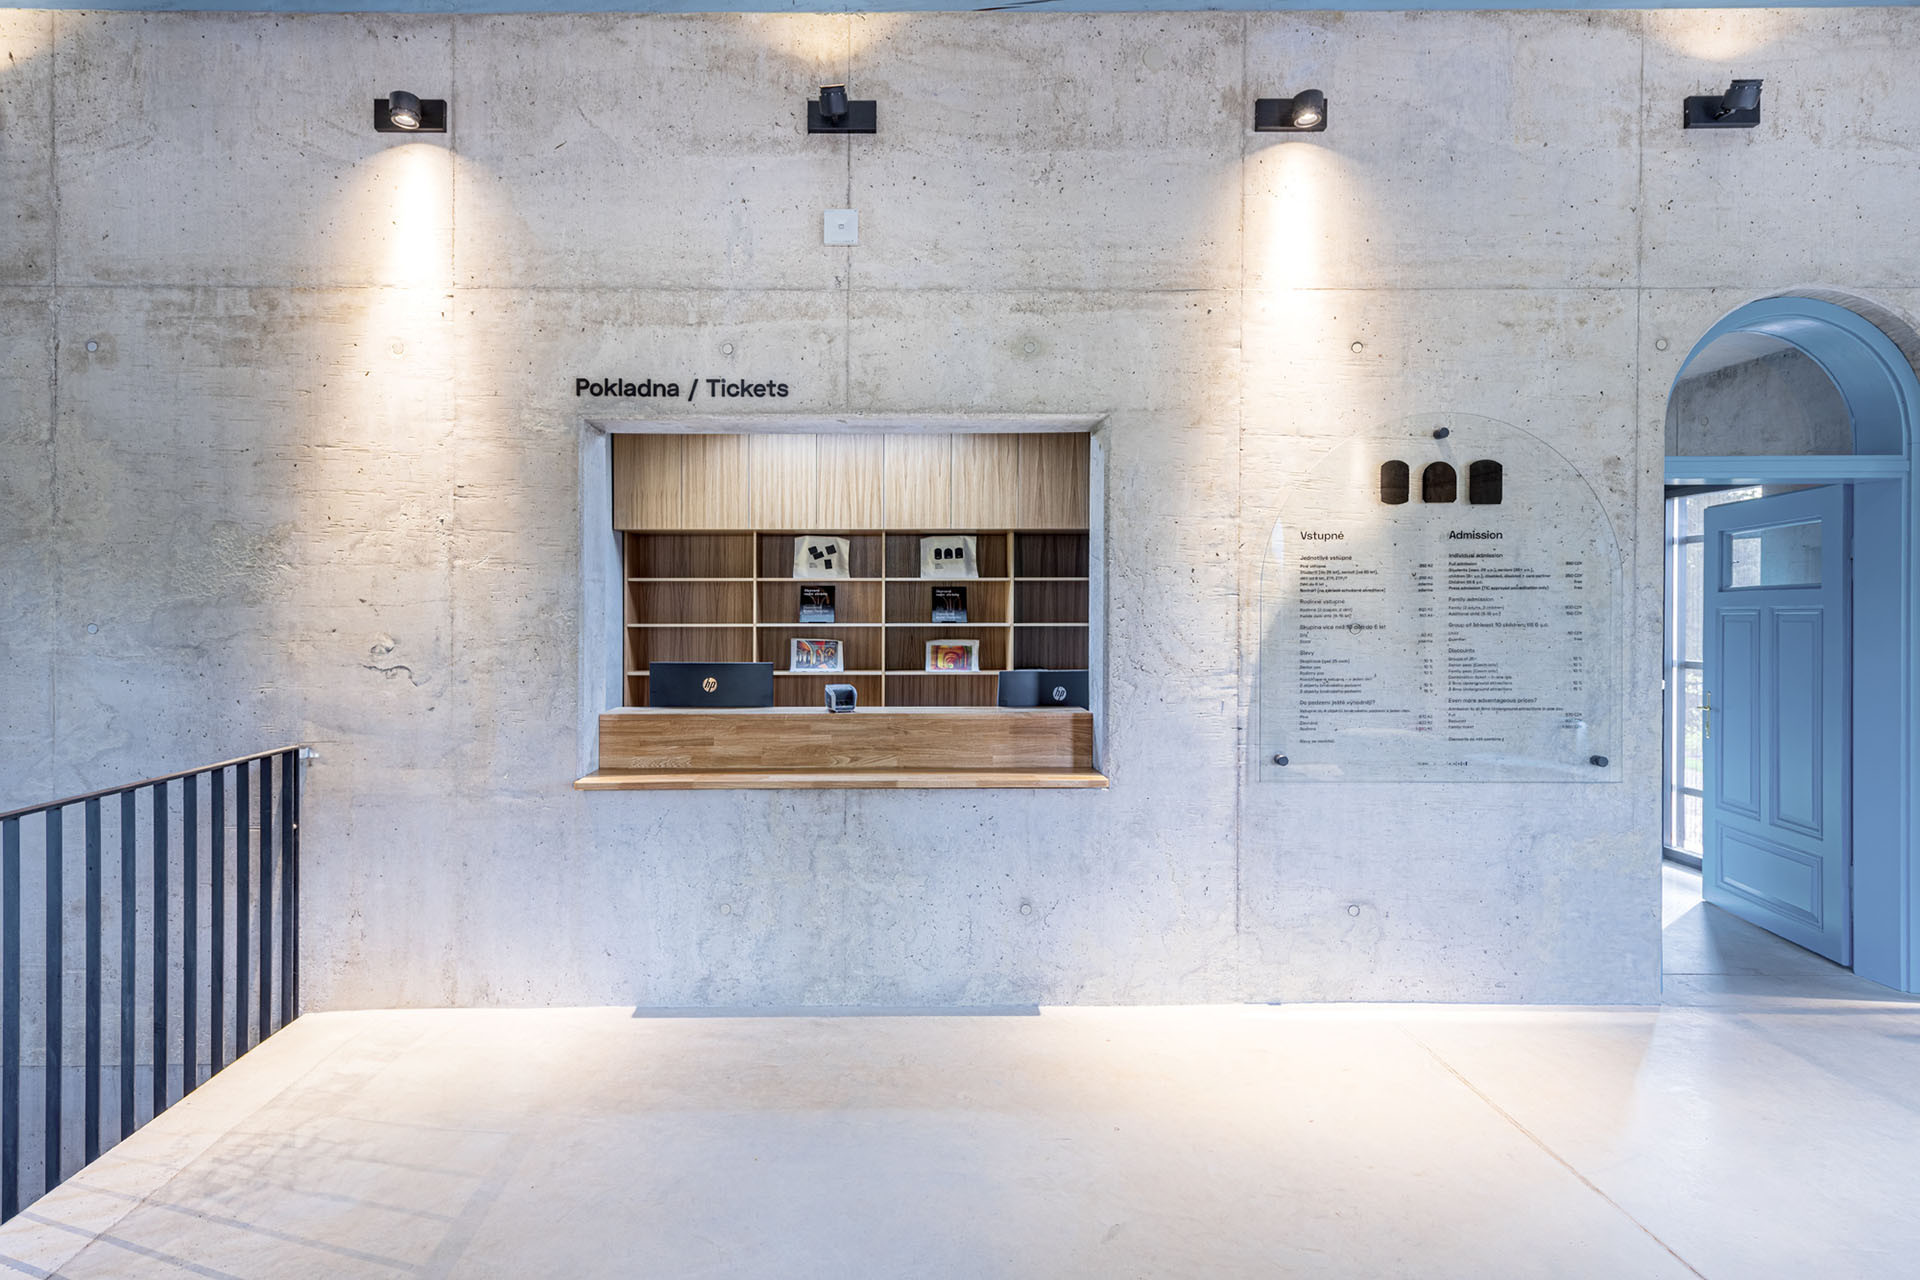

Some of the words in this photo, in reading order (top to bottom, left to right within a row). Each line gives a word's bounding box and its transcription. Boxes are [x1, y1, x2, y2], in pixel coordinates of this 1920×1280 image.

[576, 378, 679, 397] Pokladna
[688, 378, 699, 402] /
[706, 378, 789, 398] Tickets
[1300, 530, 1345, 542] Vstupné
[1448, 530, 1503, 540] Admission
[703, 677, 718, 692] hp
[1053, 686, 1066, 701] hp
